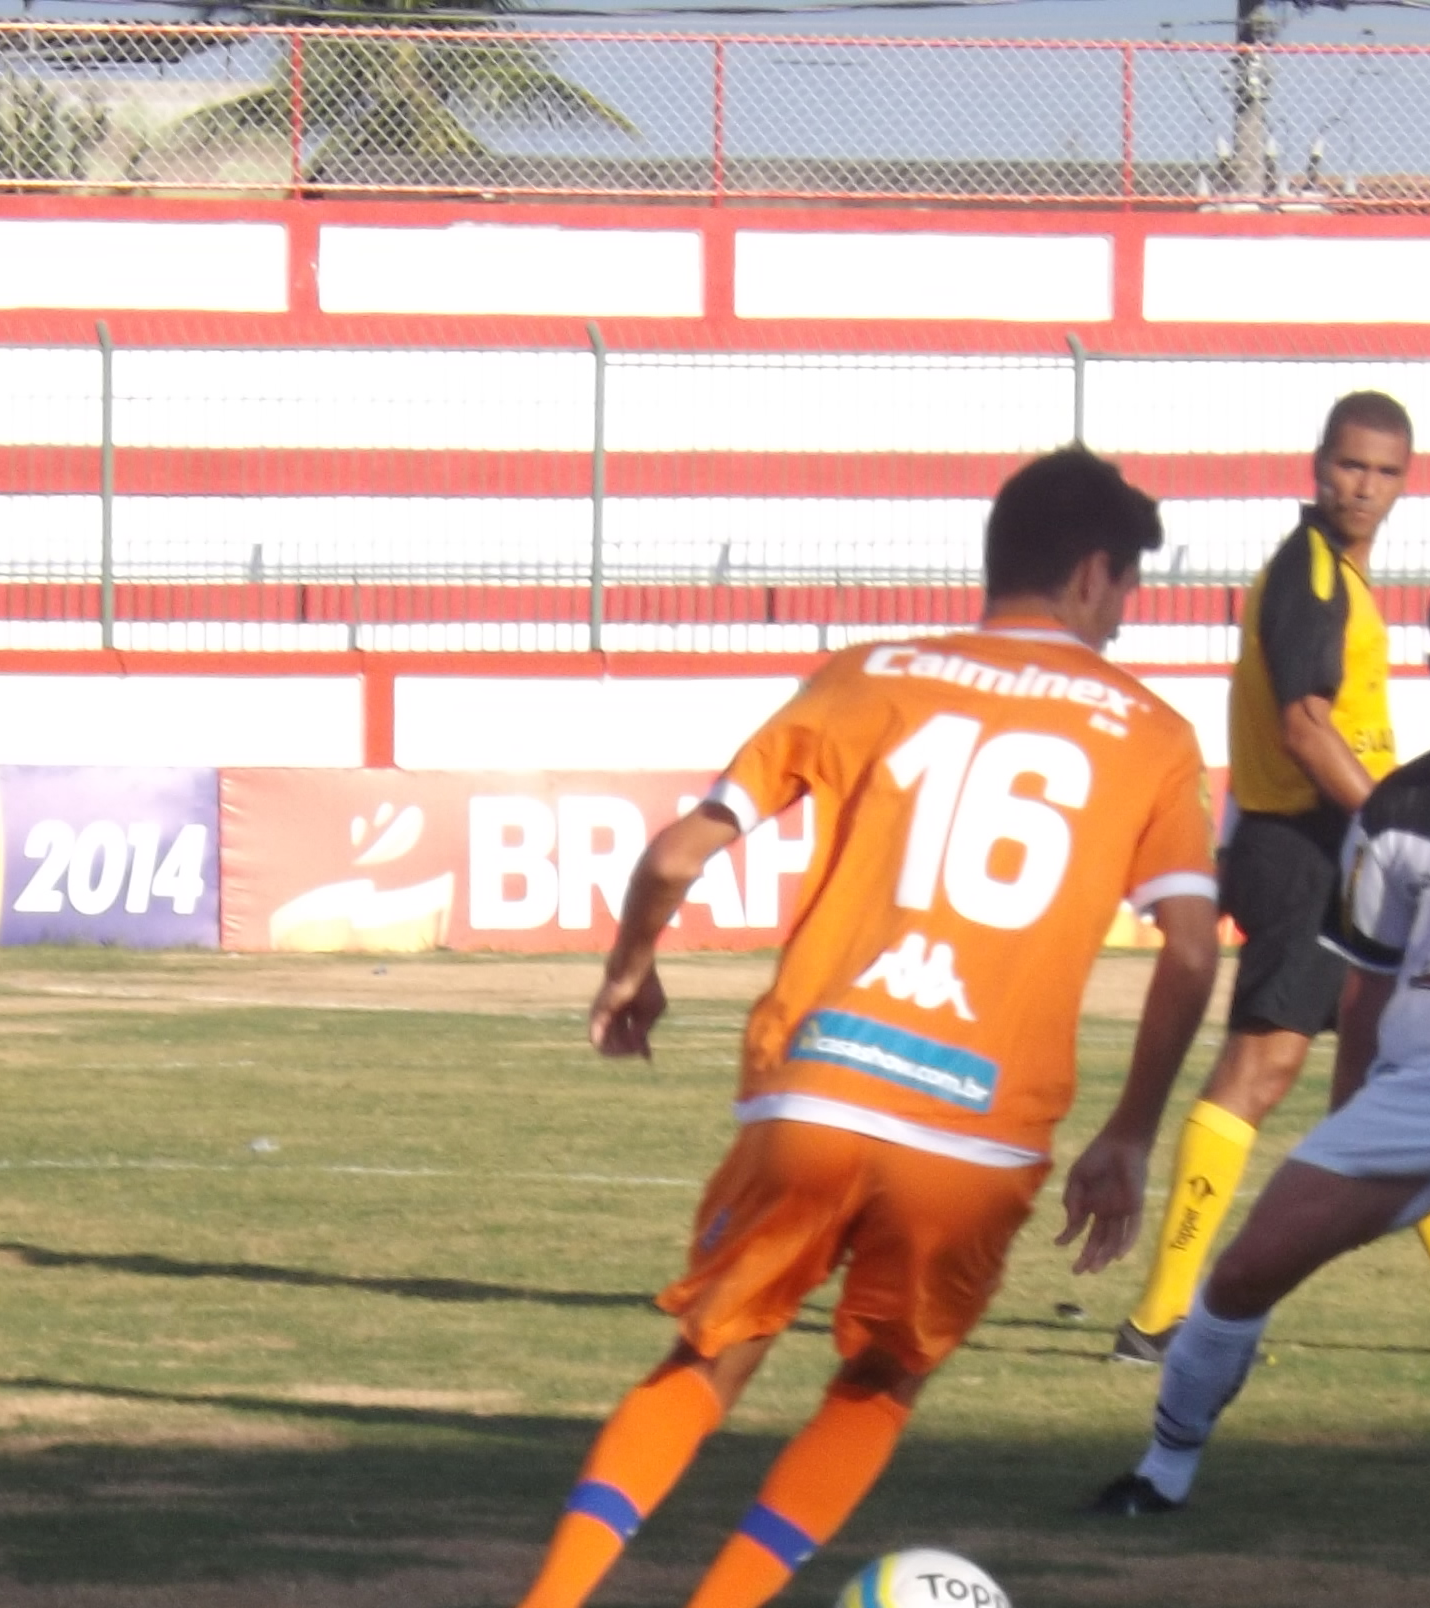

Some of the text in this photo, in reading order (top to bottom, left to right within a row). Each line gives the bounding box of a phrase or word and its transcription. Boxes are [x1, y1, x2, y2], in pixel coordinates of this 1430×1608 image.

[862, 644, 1135, 719] Calminex
[12, 819, 208, 916] 2014
[884, 712, 1092, 931] 16
